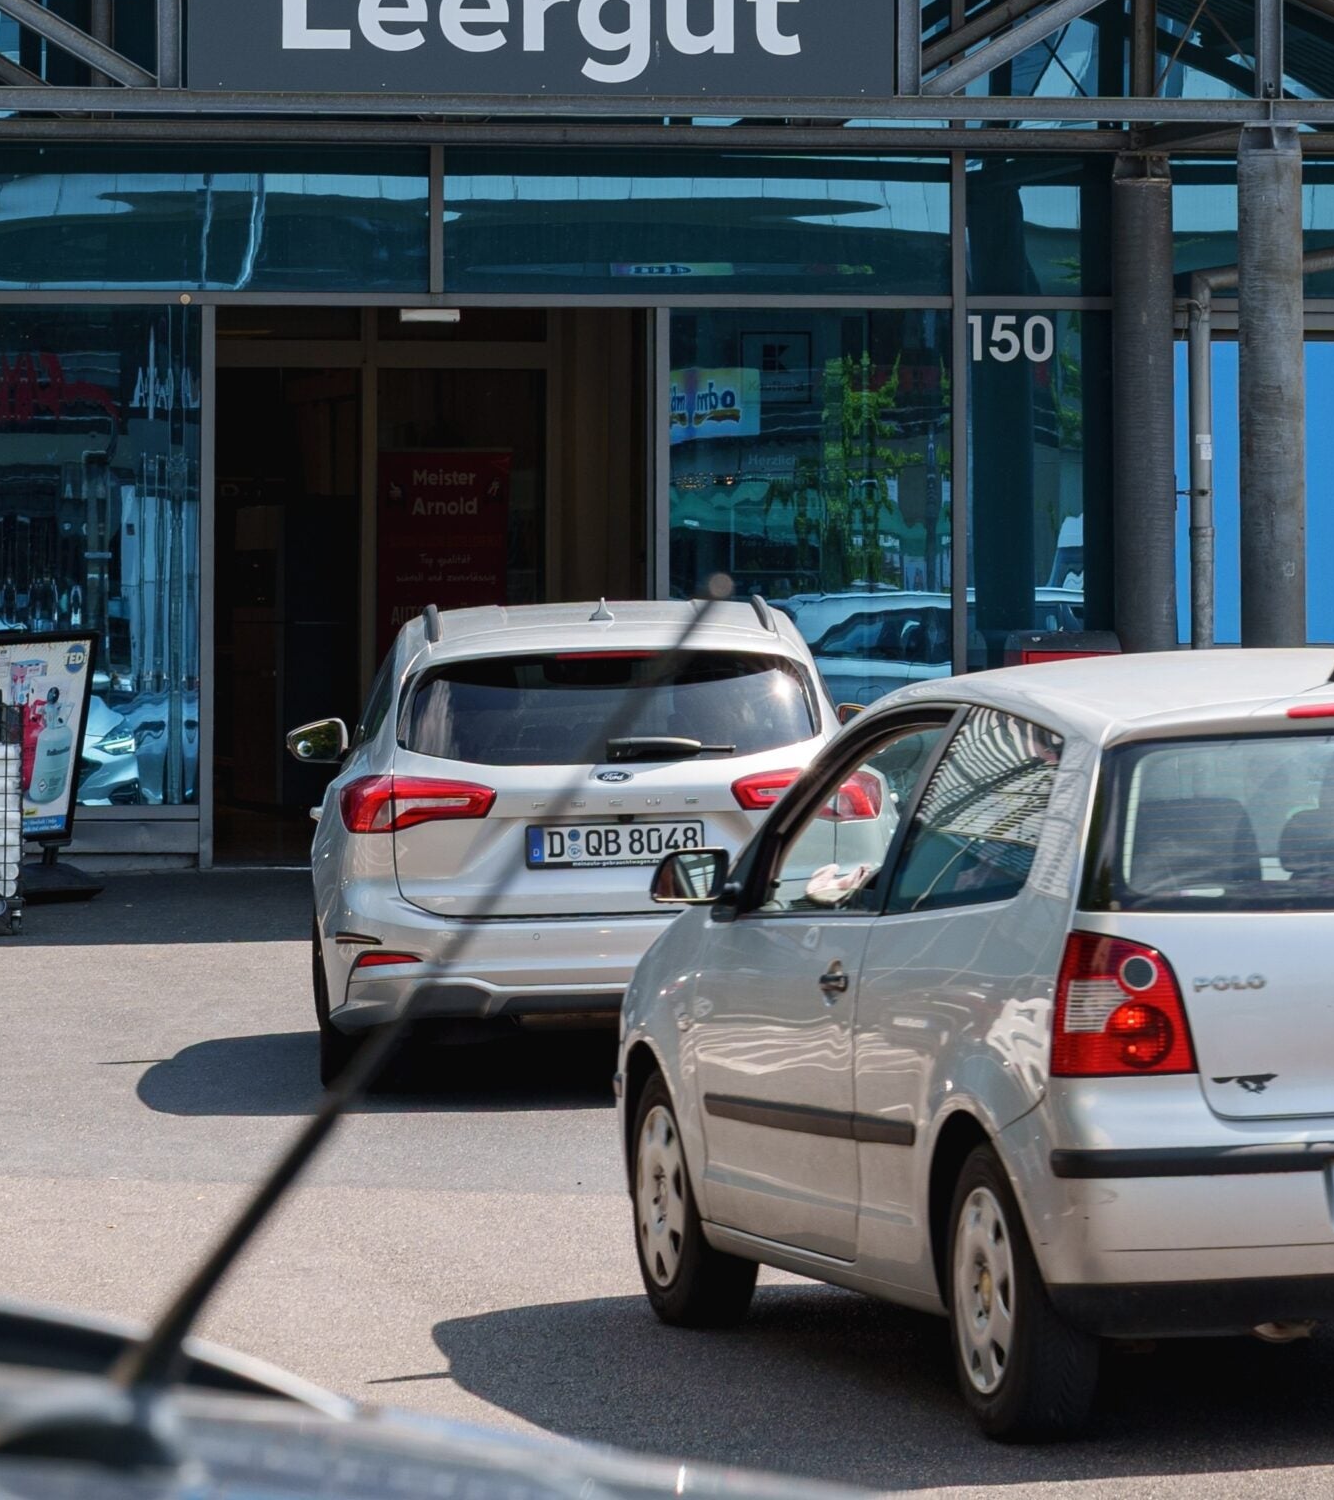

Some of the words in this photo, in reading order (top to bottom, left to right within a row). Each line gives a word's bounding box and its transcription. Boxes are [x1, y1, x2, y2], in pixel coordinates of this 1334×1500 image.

[967, 315, 1054, 362] 150
[413, 469, 476, 486] Meister
[411, 497, 478, 516] Arnold
[602, 773, 625, 781] Ford
[547, 831, 565, 858] D
[585, 829, 621, 857] QB
[629, 827, 698, 854] 8048
[1193, 974, 1266, 992] POLO
